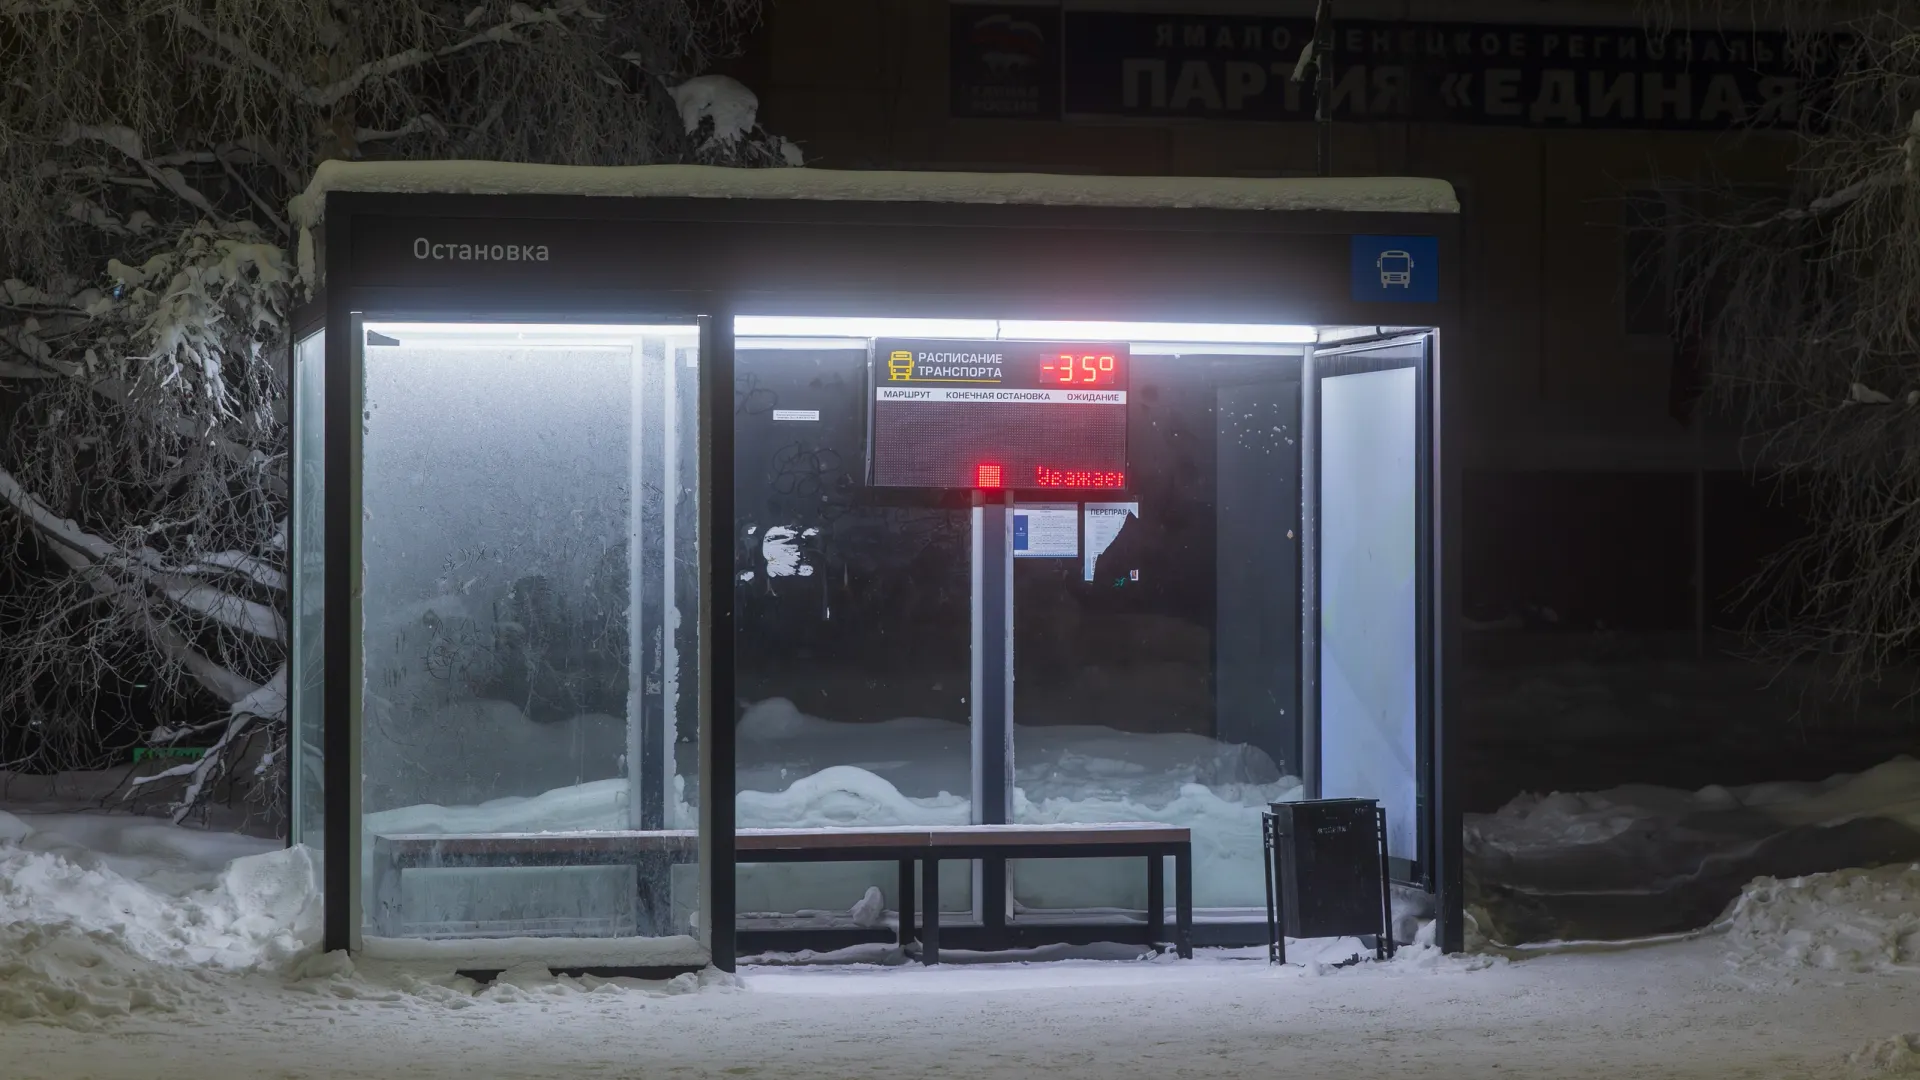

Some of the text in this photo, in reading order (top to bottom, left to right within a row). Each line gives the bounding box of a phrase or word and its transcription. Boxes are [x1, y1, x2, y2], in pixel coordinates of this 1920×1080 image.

[1122, 58, 1410, 114] ПАРТИЯ
[413, 237, 549, 261] Остановка
[917, 352, 1003, 364] РАСПИСАНИЕ
[917, 366, 1003, 378] ТРАНСПОРТА
[883, 390, 1120, 402] МАРШРУТ КОНЕЧНАЯ ОСТАНОВКА ОЖИДАНИЕ
